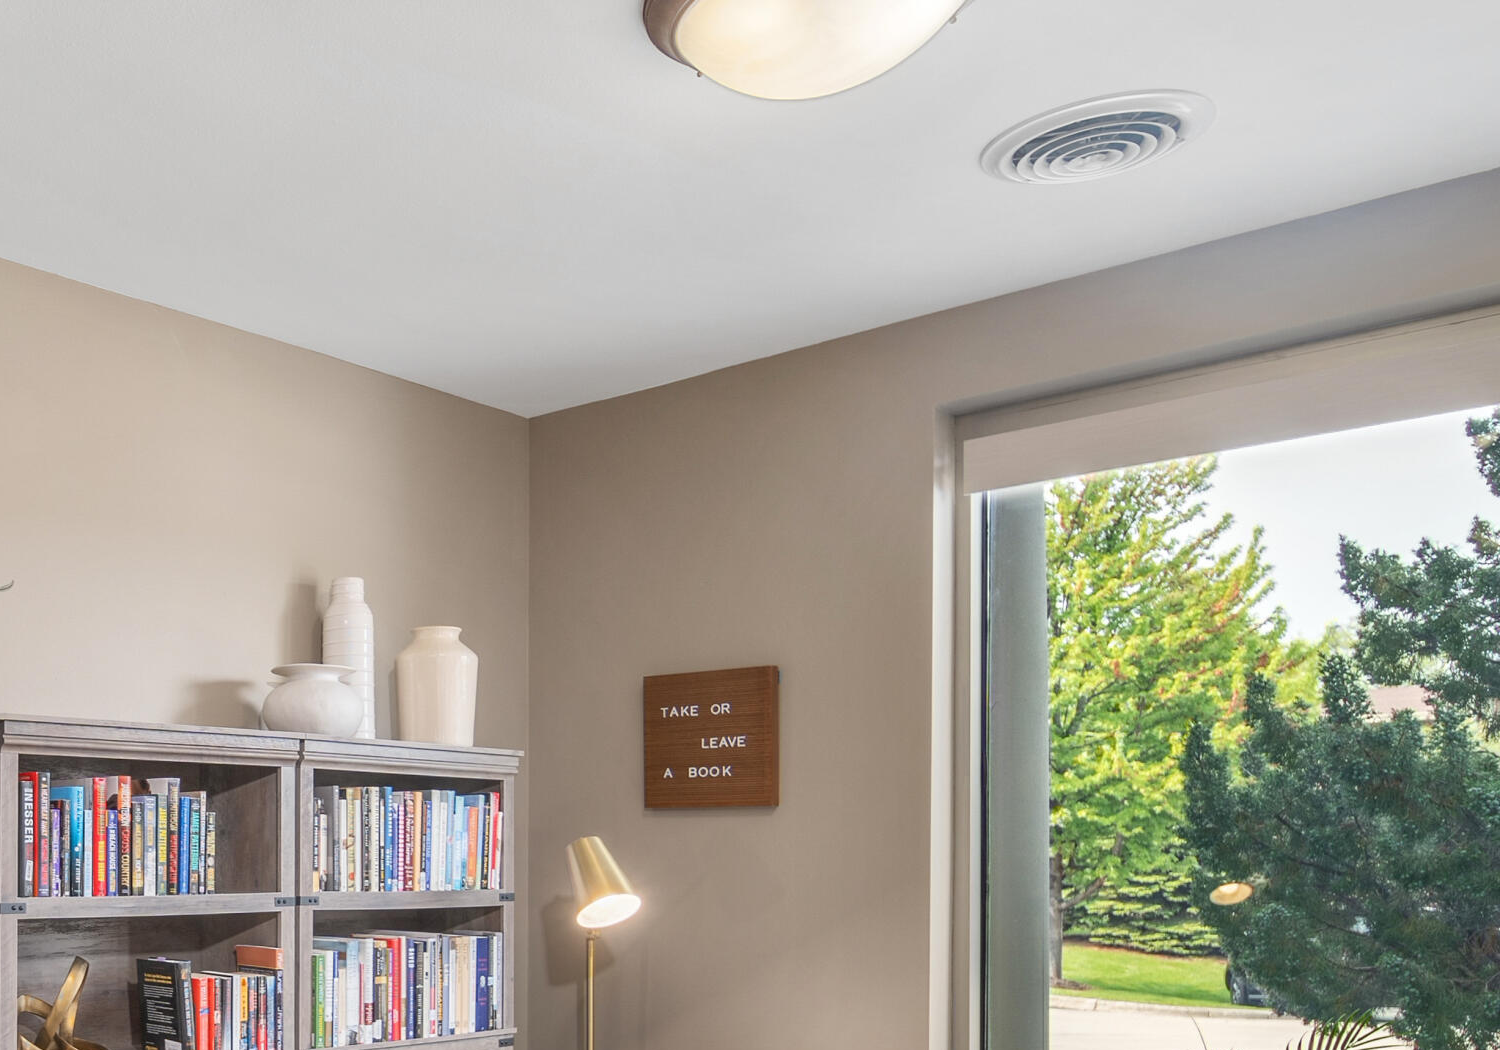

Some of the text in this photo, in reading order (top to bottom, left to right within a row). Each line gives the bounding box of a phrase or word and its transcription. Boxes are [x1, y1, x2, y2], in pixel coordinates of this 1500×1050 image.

[661, 703, 730, 718] TAKE OR
[701, 736, 746, 749] LEAVE
[663, 766, 732, 778] A BOOK
[121, 855, 129, 886] COUNTRY
